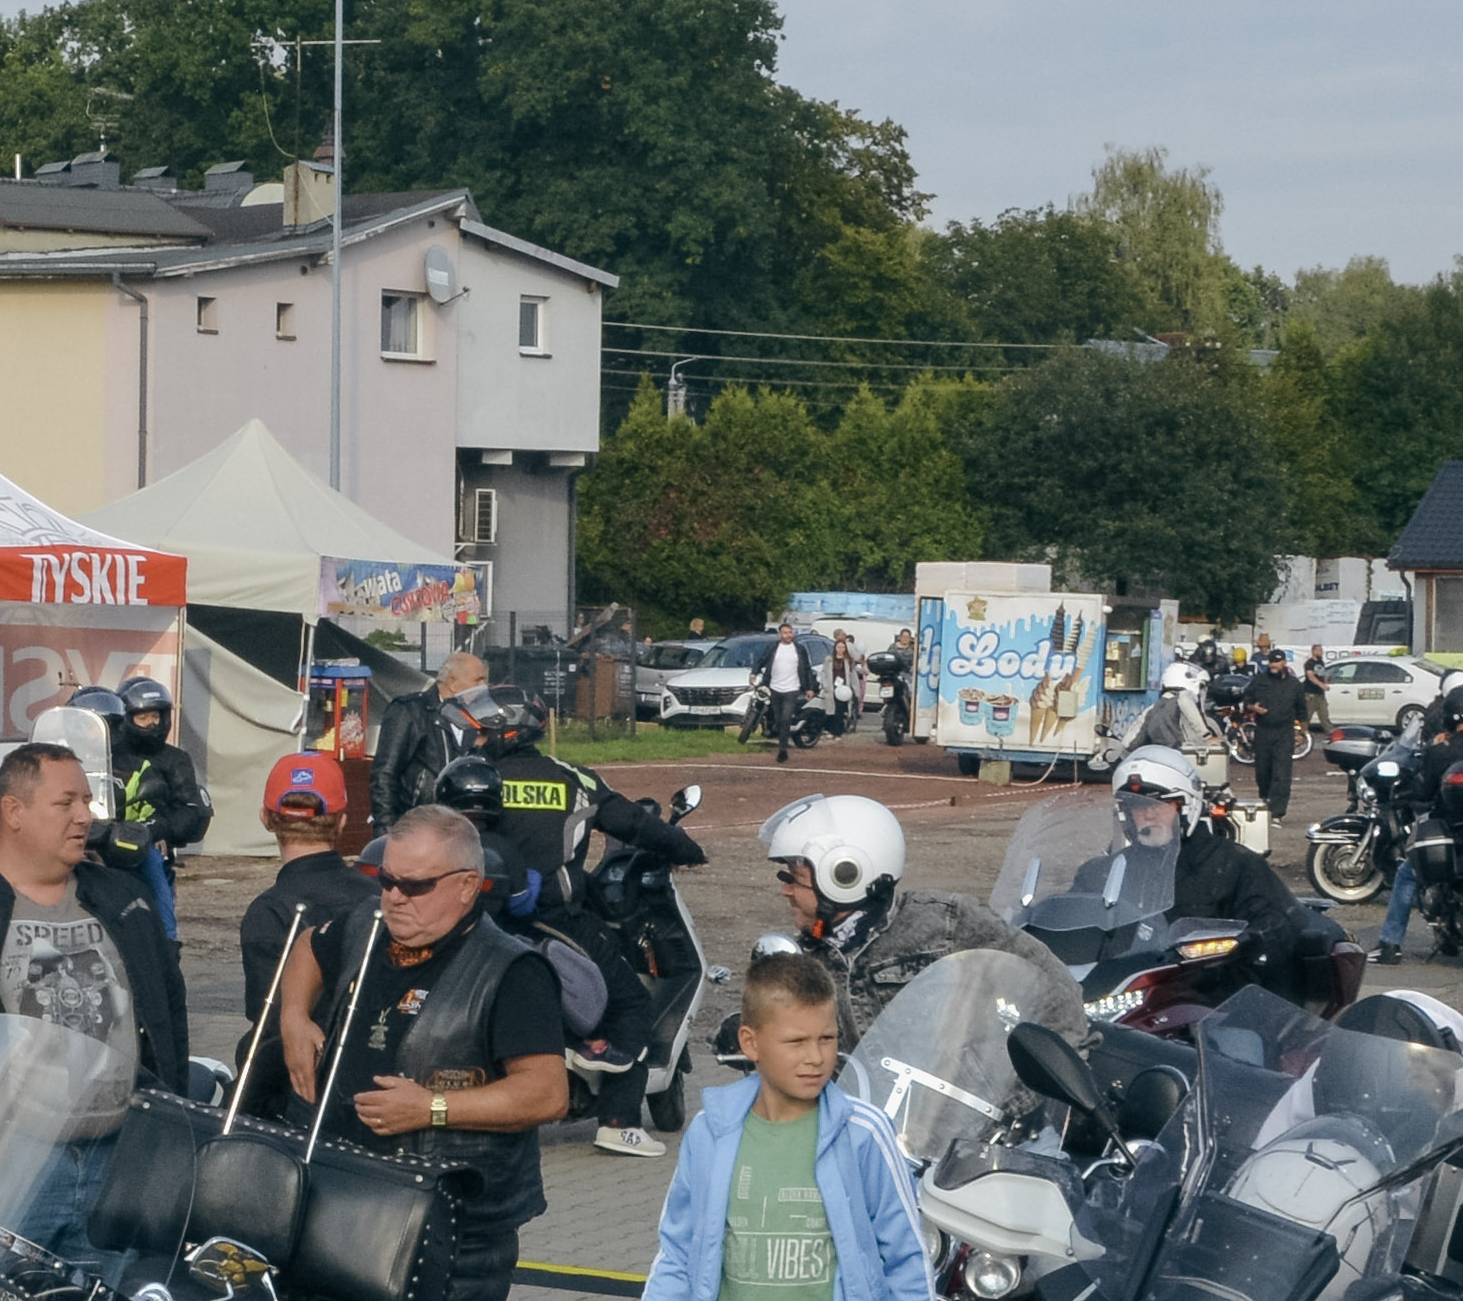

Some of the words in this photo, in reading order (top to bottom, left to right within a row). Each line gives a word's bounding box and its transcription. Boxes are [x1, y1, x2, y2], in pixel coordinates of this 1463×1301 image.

[21, 554, 148, 605] TYSKIE
[16, 922, 105, 949] SPEED
[766, 1237, 825, 1280] VIBES
